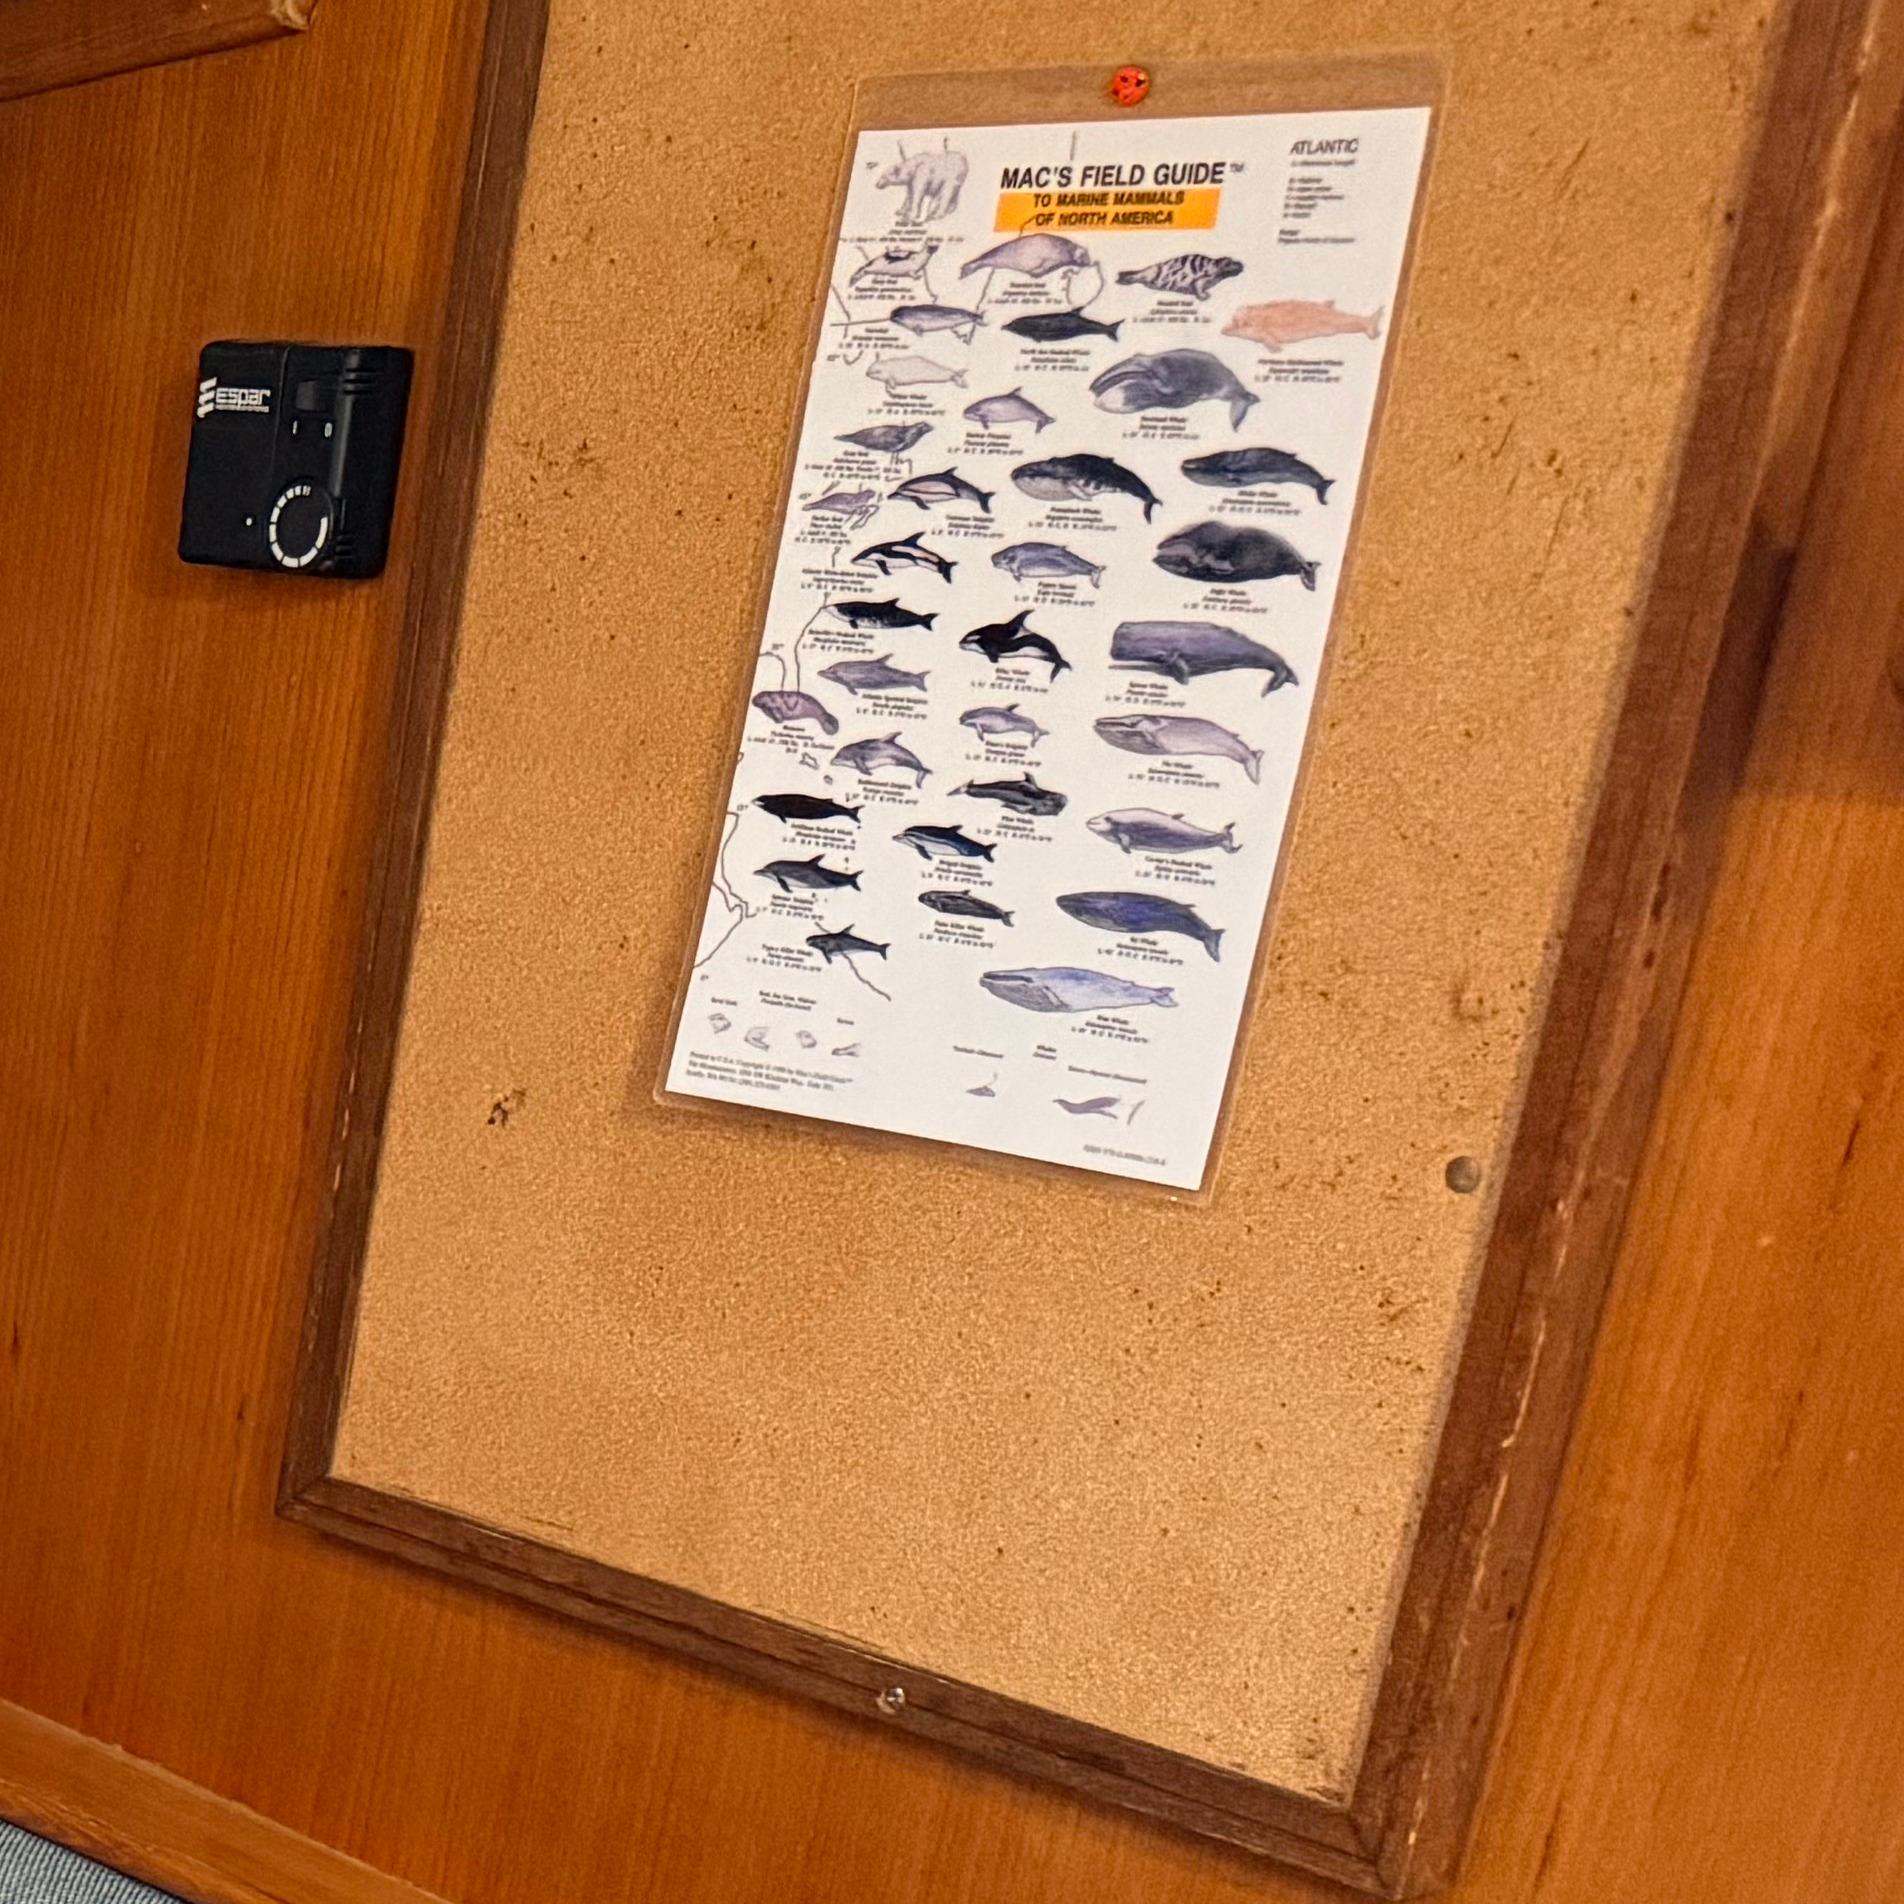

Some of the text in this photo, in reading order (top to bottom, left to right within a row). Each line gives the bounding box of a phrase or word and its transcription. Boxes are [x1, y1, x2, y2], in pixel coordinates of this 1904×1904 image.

[1289, 138, 1359, 155] ATLANTIC
[1001, 166, 1072, 189] MAC'S
[1080, 163, 1145, 187] FIELD
[1034, 190, 1185, 207] TO MARINE MAMMALS
[1035, 211, 1174, 226] OF NORTH AMERICA
